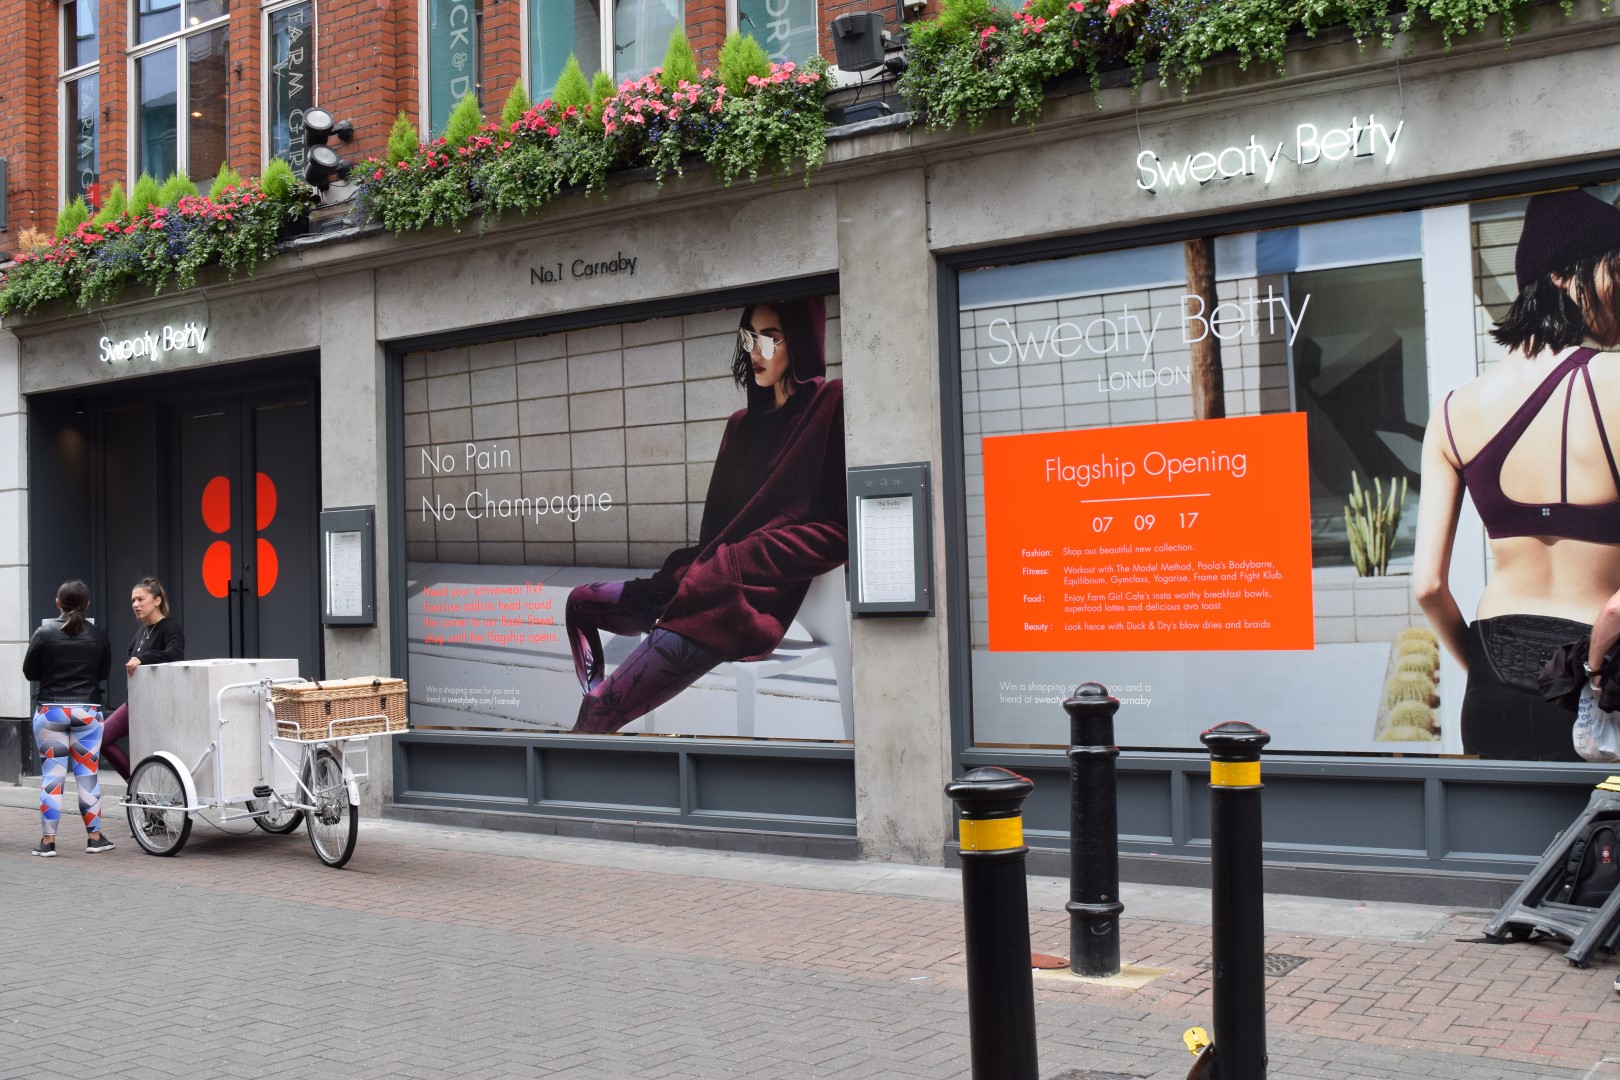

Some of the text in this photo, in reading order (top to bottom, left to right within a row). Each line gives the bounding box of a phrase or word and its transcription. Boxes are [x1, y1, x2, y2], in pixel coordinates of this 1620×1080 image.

[288, 9, 304, 100] FARM
[452, 52, 468, 72] &
[82, 80, 94, 160] FARM
[1135, 114, 1404, 190] Sweaty Betty
[530, 251, 637, 284] No.1 Carnaby
[988, 285, 1311, 366] Sweaty Betty
[100, 322, 207, 362] Sweaty Betty
[1098, 365, 1191, 392] LONDON
[422, 444, 511, 474] No Pain
[1046, 450, 1246, 488] Flagship Opening
[422, 489, 612, 524] No Champagne
[1092, 512, 1198, 532] 07 09 17
[1022, 548, 1052, 558] Fashion:
[1062, 547, 1082, 556] Shop
[1100, 544, 1132, 554] beautiful
[1154, 543, 1195, 552] collection.
[1022, 567, 1049, 576] Fitness:
[1064, 560, 1274, 574] Workout with The Model Method, Paola's Bodybarre,
[1064, 570, 1284, 587] Equilibrium, Gymclass, Yogarise, Frame and Fight Klub.
[424, 582, 543, 598] Need your activewear fix?
[1064, 594, 1085, 603] Enjoy
[1108, 592, 1122, 600] Girl
[1125, 592, 1150, 600] Cafe's
[1153, 592, 1171, 600] insta
[1174, 590, 1200, 601] worthy
[1204, 589, 1241, 599] breakfast
[1244, 588, 1272, 598] bowls,
[424, 598, 552, 612] Exercise addicts head round
[1064, 603, 1102, 614] superfood
[1104, 602, 1125, 612] lattes
[1128, 602, 1142, 611] and
[1146, 602, 1180, 611] delicious
[1201, 602, 1223, 610] toast.
[424, 614, 554, 628] the corner to our Beak Street
[1064, 619, 1270, 631] Look fierce with Duck & Dry's blow dries and braids
[424, 630, 560, 646] shop until the Flagship opens.
[426, 686, 438, 694] Win
[444, 686, 468, 696] shopping
[484, 686, 492, 694] for
[492, 688, 502, 696] you
[504, 686, 514, 694] and
[1000, 682, 1018, 691] Win
[1020, 684, 1026, 692] a
[1028, 682, 1066, 694] shopping
[1108, 684, 1122, 694] you
[1126, 682, 1142, 692] and
[1144, 684, 1150, 692] a
[426, 695, 440, 703] friend
[1000, 695, 1022, 704] friend
[1024, 696, 1032, 704] at
